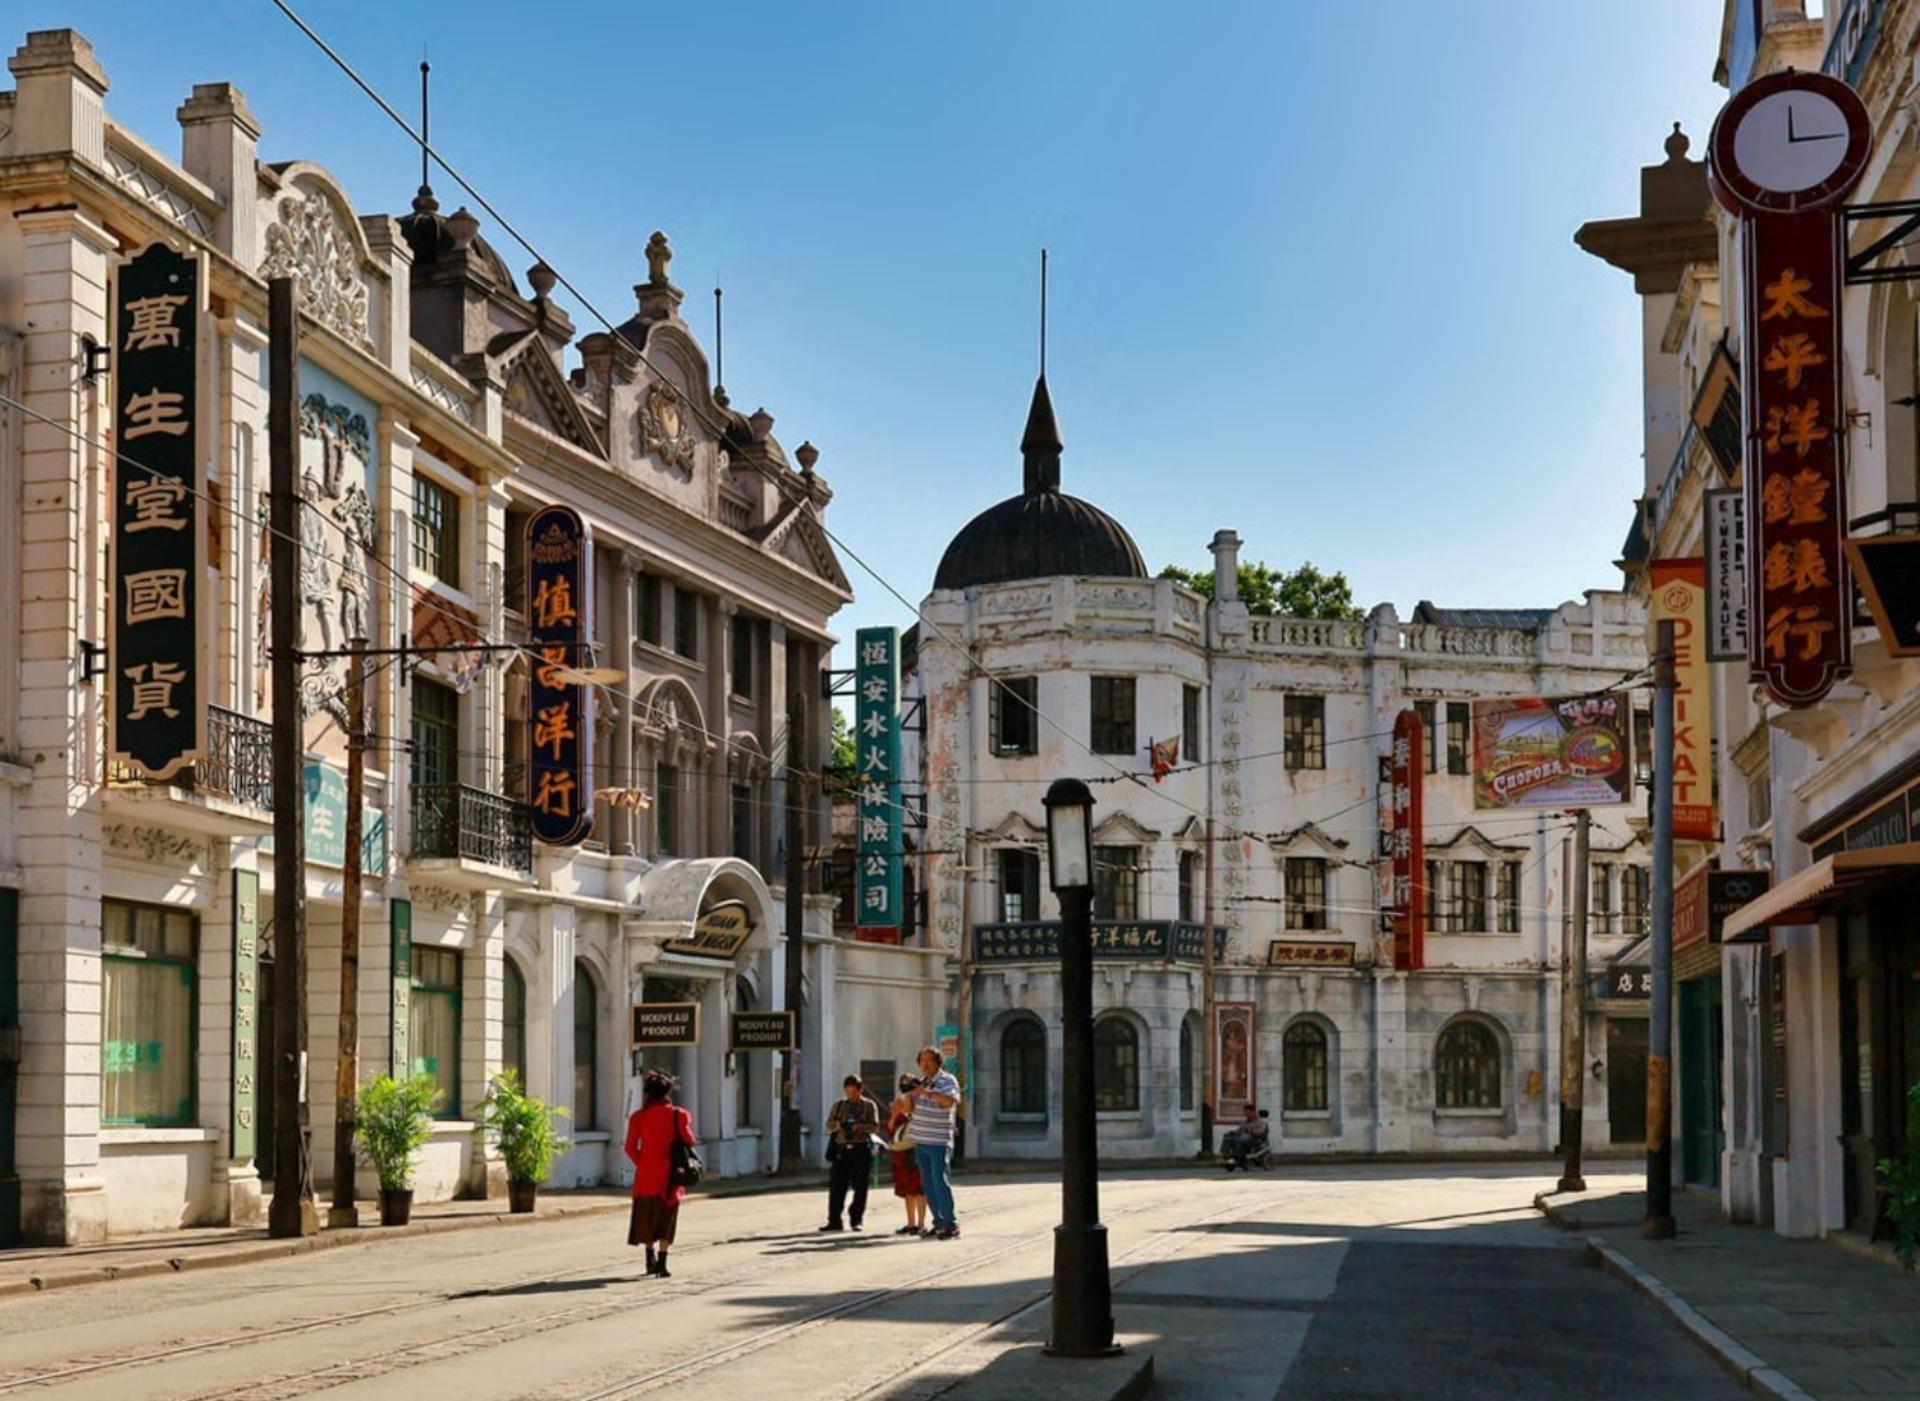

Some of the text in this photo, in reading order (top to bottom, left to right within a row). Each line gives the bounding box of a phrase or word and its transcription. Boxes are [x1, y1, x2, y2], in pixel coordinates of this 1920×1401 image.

[124, 293, 189, 721] 萬生堂國貨
[641, 1012, 689, 1023] NOUVEAU
[642, 1025, 687, 1036] PRODUIT
